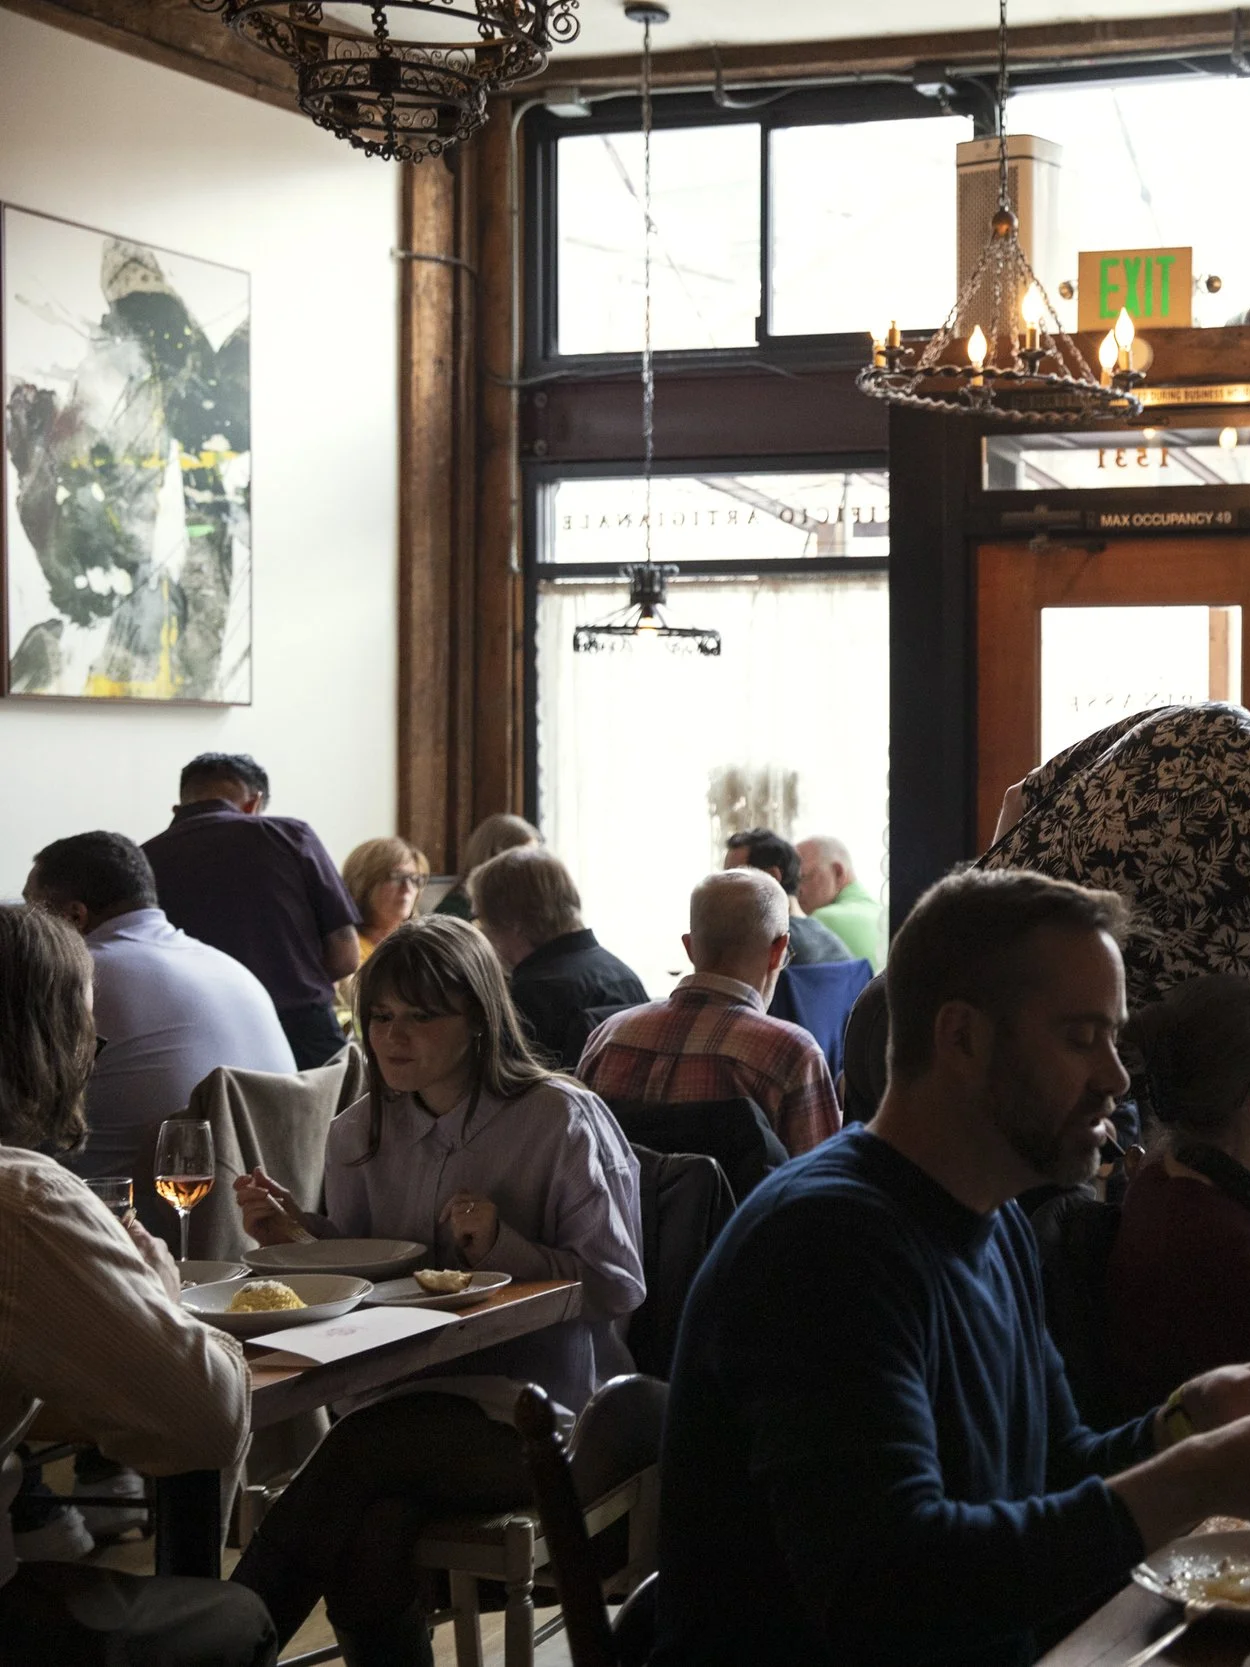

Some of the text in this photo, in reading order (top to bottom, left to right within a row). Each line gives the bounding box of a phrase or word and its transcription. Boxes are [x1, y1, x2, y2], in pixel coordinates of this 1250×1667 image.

[1099, 256, 1176, 318] EXIT
[1184, 389, 1224, 400] BUSINESS
[1100, 511, 1232, 527] MAX OCCUPANCY 49
